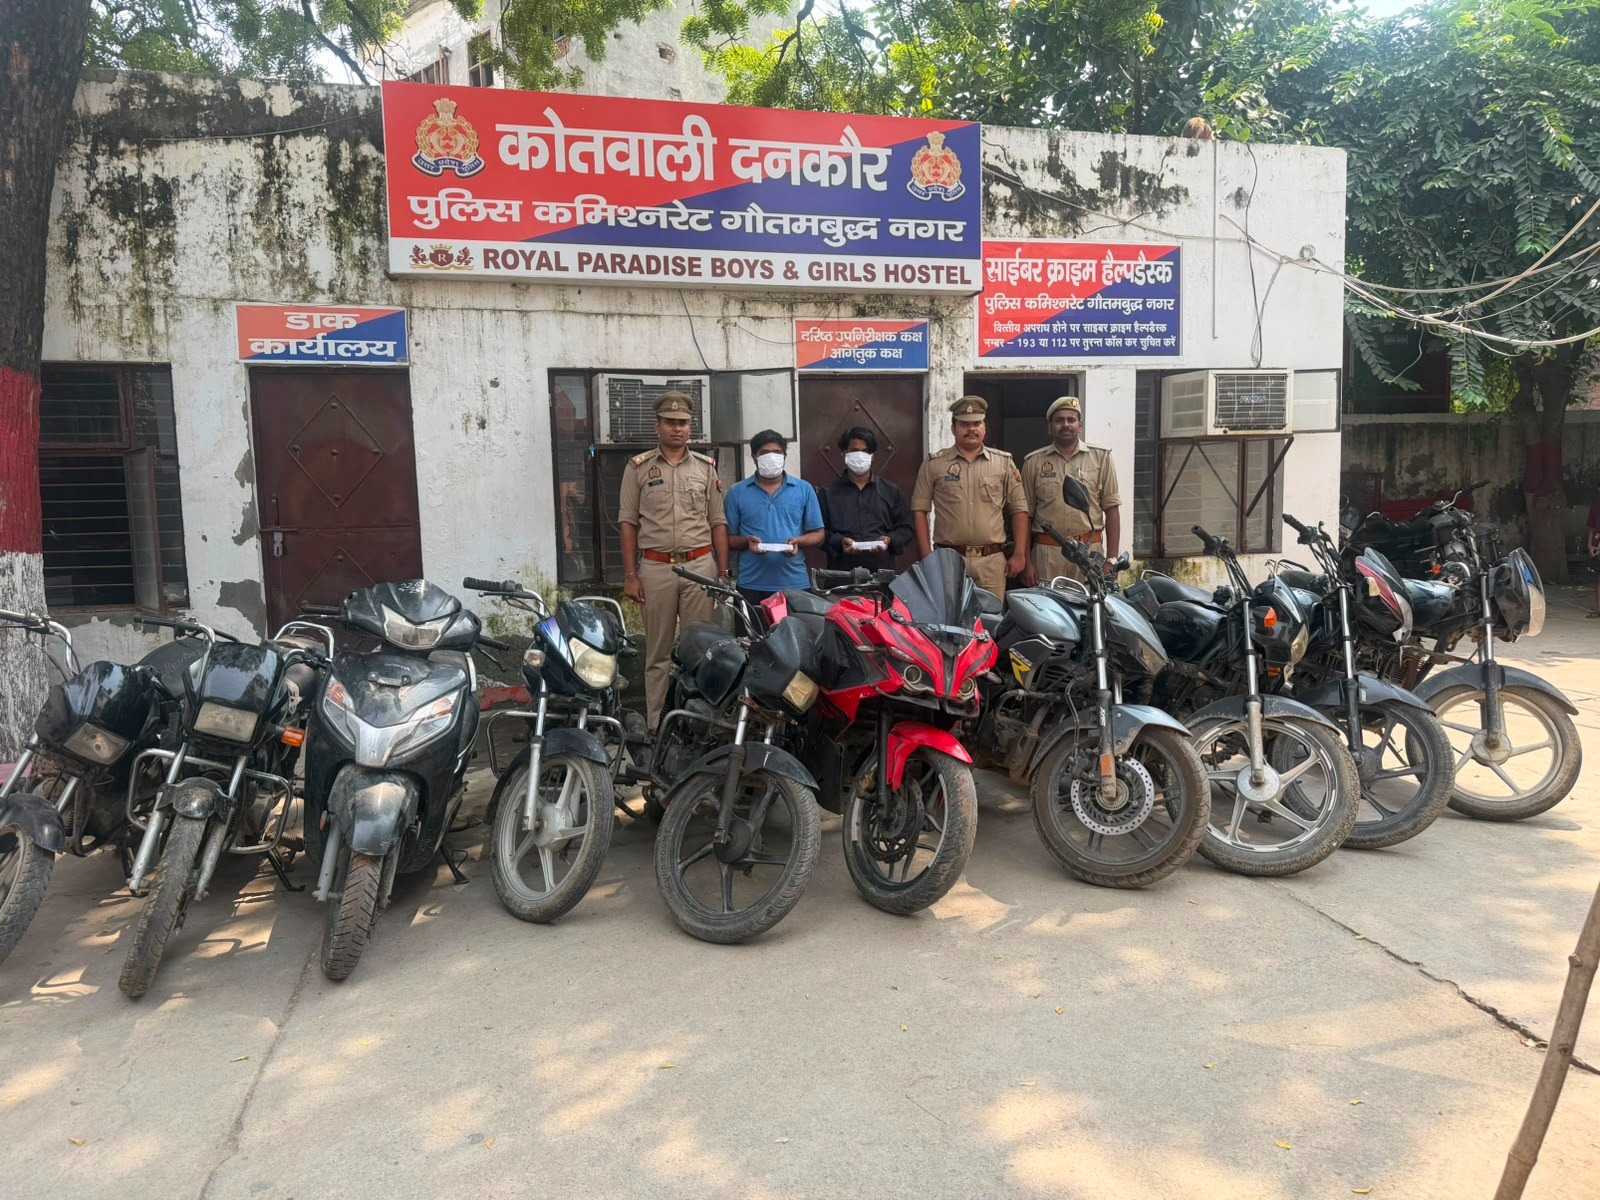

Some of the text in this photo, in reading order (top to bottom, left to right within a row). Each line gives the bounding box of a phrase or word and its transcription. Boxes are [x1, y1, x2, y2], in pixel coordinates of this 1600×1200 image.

[495, 106, 892, 191] कोतवाली दनकौर
[407, 187, 967, 247] पुलिस कमिश्नरेट गौतमबुद्ध नगर
[438, 253, 447, 263] R
[482, 248, 971, 285] ROYAL PARADISE BOYS & GIRLS HOSTEL
[985, 248, 1174, 287] साईबर क्राइम हैल्पडैस्क
[984, 292, 1175, 315] पुलिस कमिश्नरेट गौतमबुद्ध नगर
[284, 312, 360, 330] डाक
[1023, 323, 1050, 333] अपराध
[1052, 321, 1066, 333] होने
[1070, 323, 1080, 333] पर
[1110, 323, 1131, 334] क्राइम
[835, 327, 898, 342] उपनिरीक्षक
[900, 331, 923, 342] कक्ष
[984, 338, 1005, 348] नम्बर
[1017, 338, 1036, 348] 193
[1038, 338, 1048, 348] या
[1052, 338, 1067, 348] 112
[1070, 339, 1080, 348] पर
[1105, 336, 1123, 348] कॉल
[1125, 339, 1137, 348] कर
[248, 333, 397, 357] कार्यालय
[880, 348, 903, 358] कक्ष
